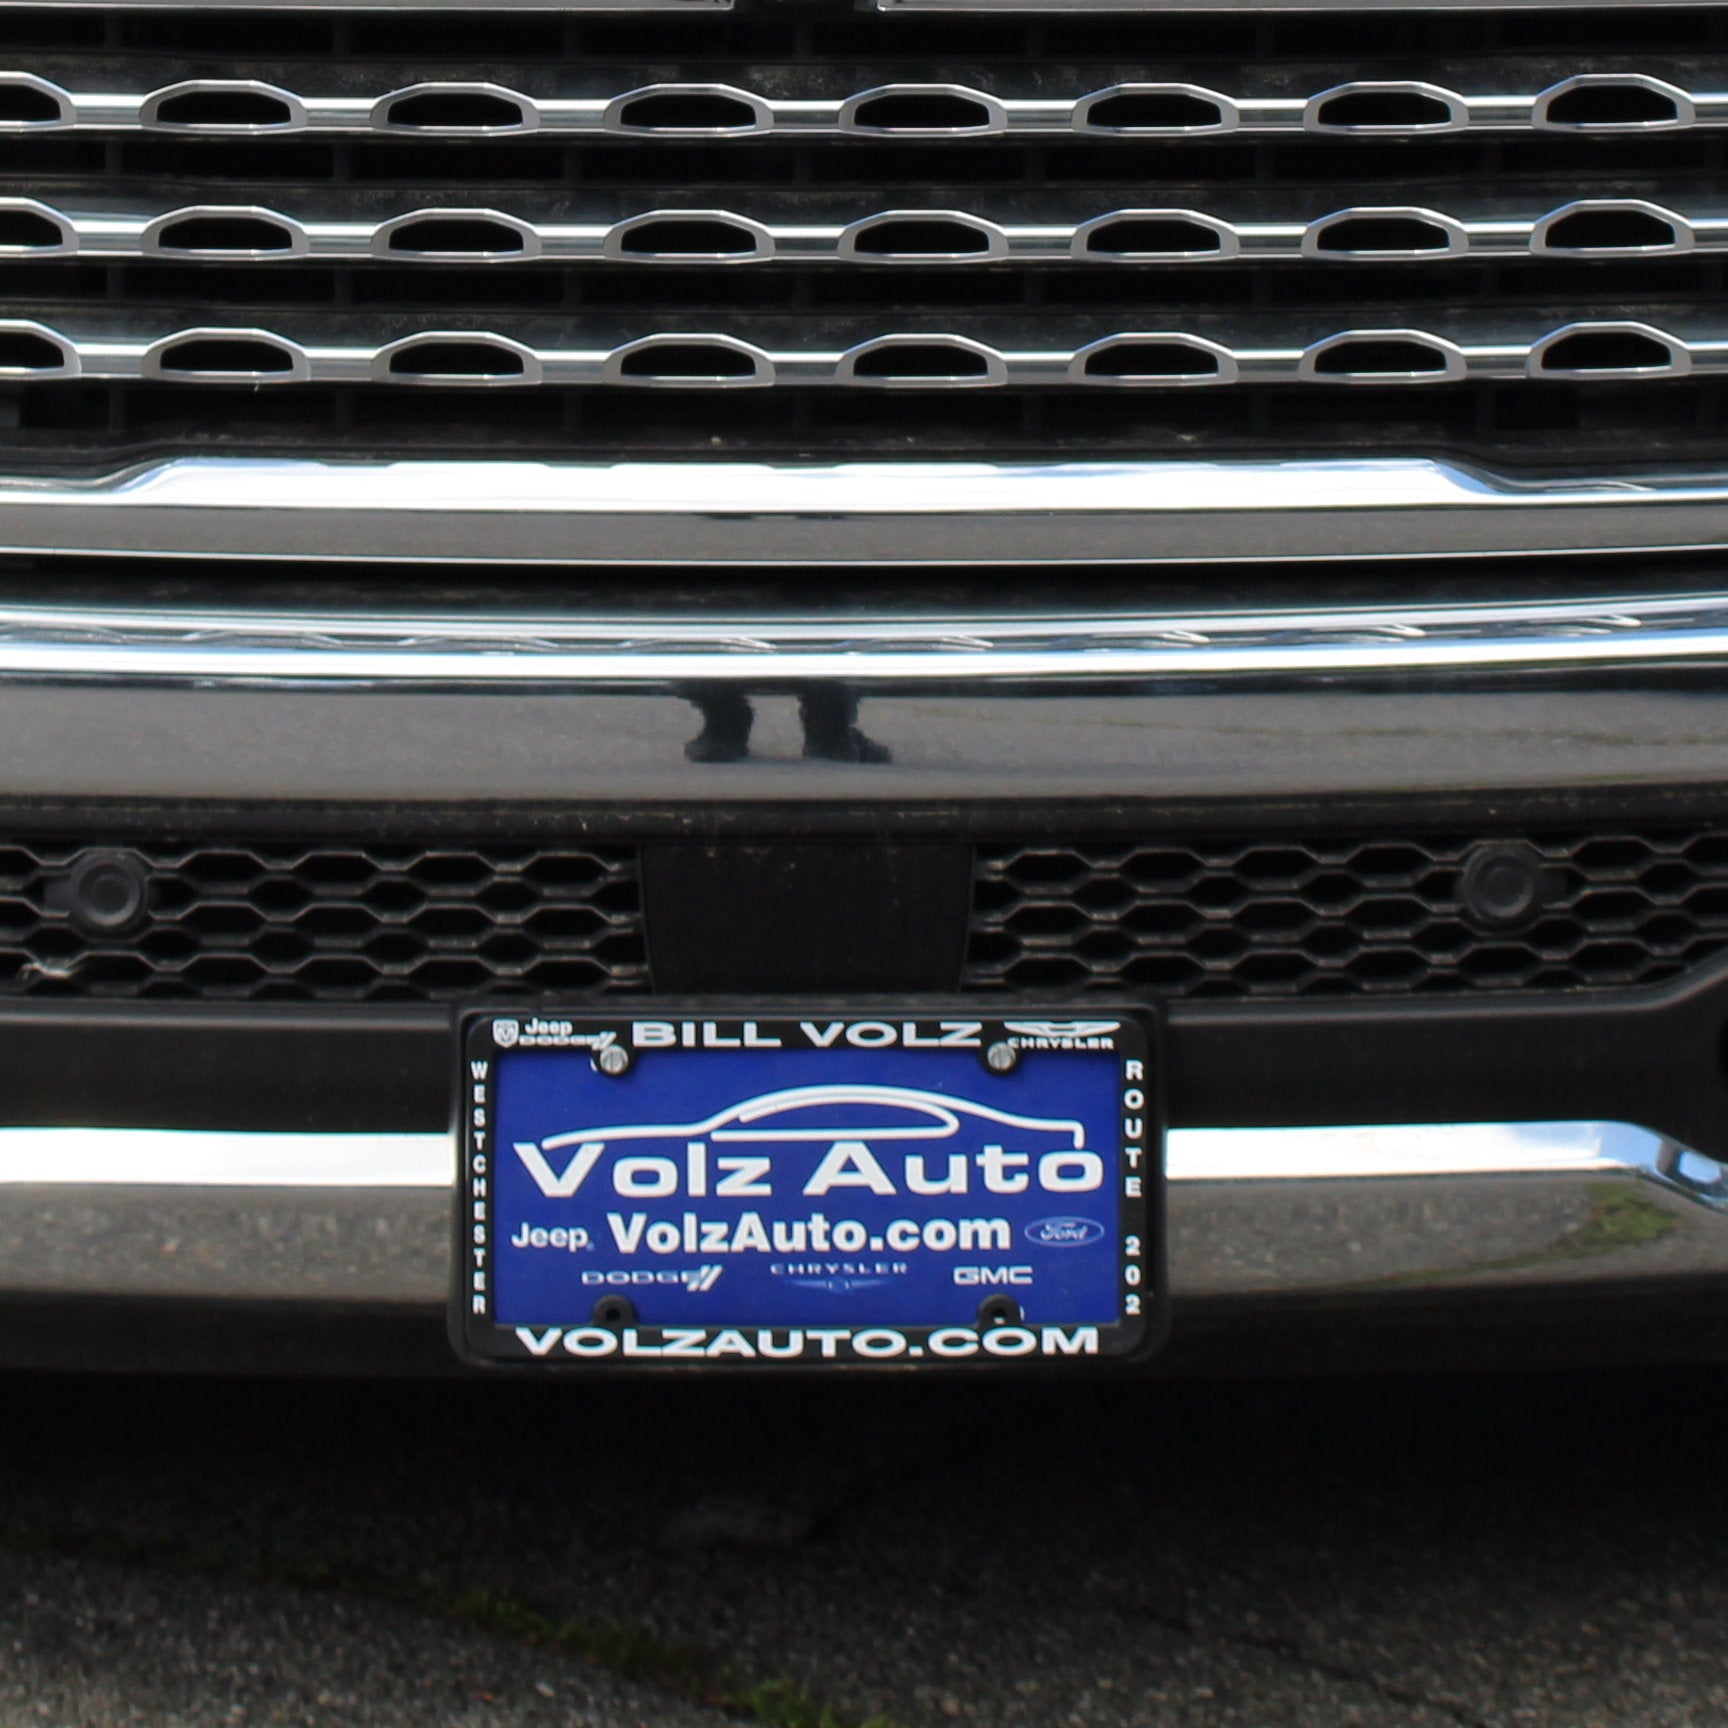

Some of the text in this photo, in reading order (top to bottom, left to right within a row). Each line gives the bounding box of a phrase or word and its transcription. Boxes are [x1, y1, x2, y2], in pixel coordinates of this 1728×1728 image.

[524, 1017, 573, 1036] Jeep
[632, 1021, 983, 1048] BILL VOLZ
[1006, 1036, 1115, 1050] CHRYSLER
[513, 1140, 1104, 1199] Volz Auto
[511, 1222, 589, 1253] Jeep
[606, 1211, 1011, 1254] VolzAuto.com
[1039, 1221, 1088, 1241] Ford
[581, 1271, 699, 1286] DODGE
[770, 1262, 908, 1276] CHRYSLER
[953, 1265, 1034, 1286] GMC
[515, 1326, 1100, 1358] VOLZAUTO.COM
